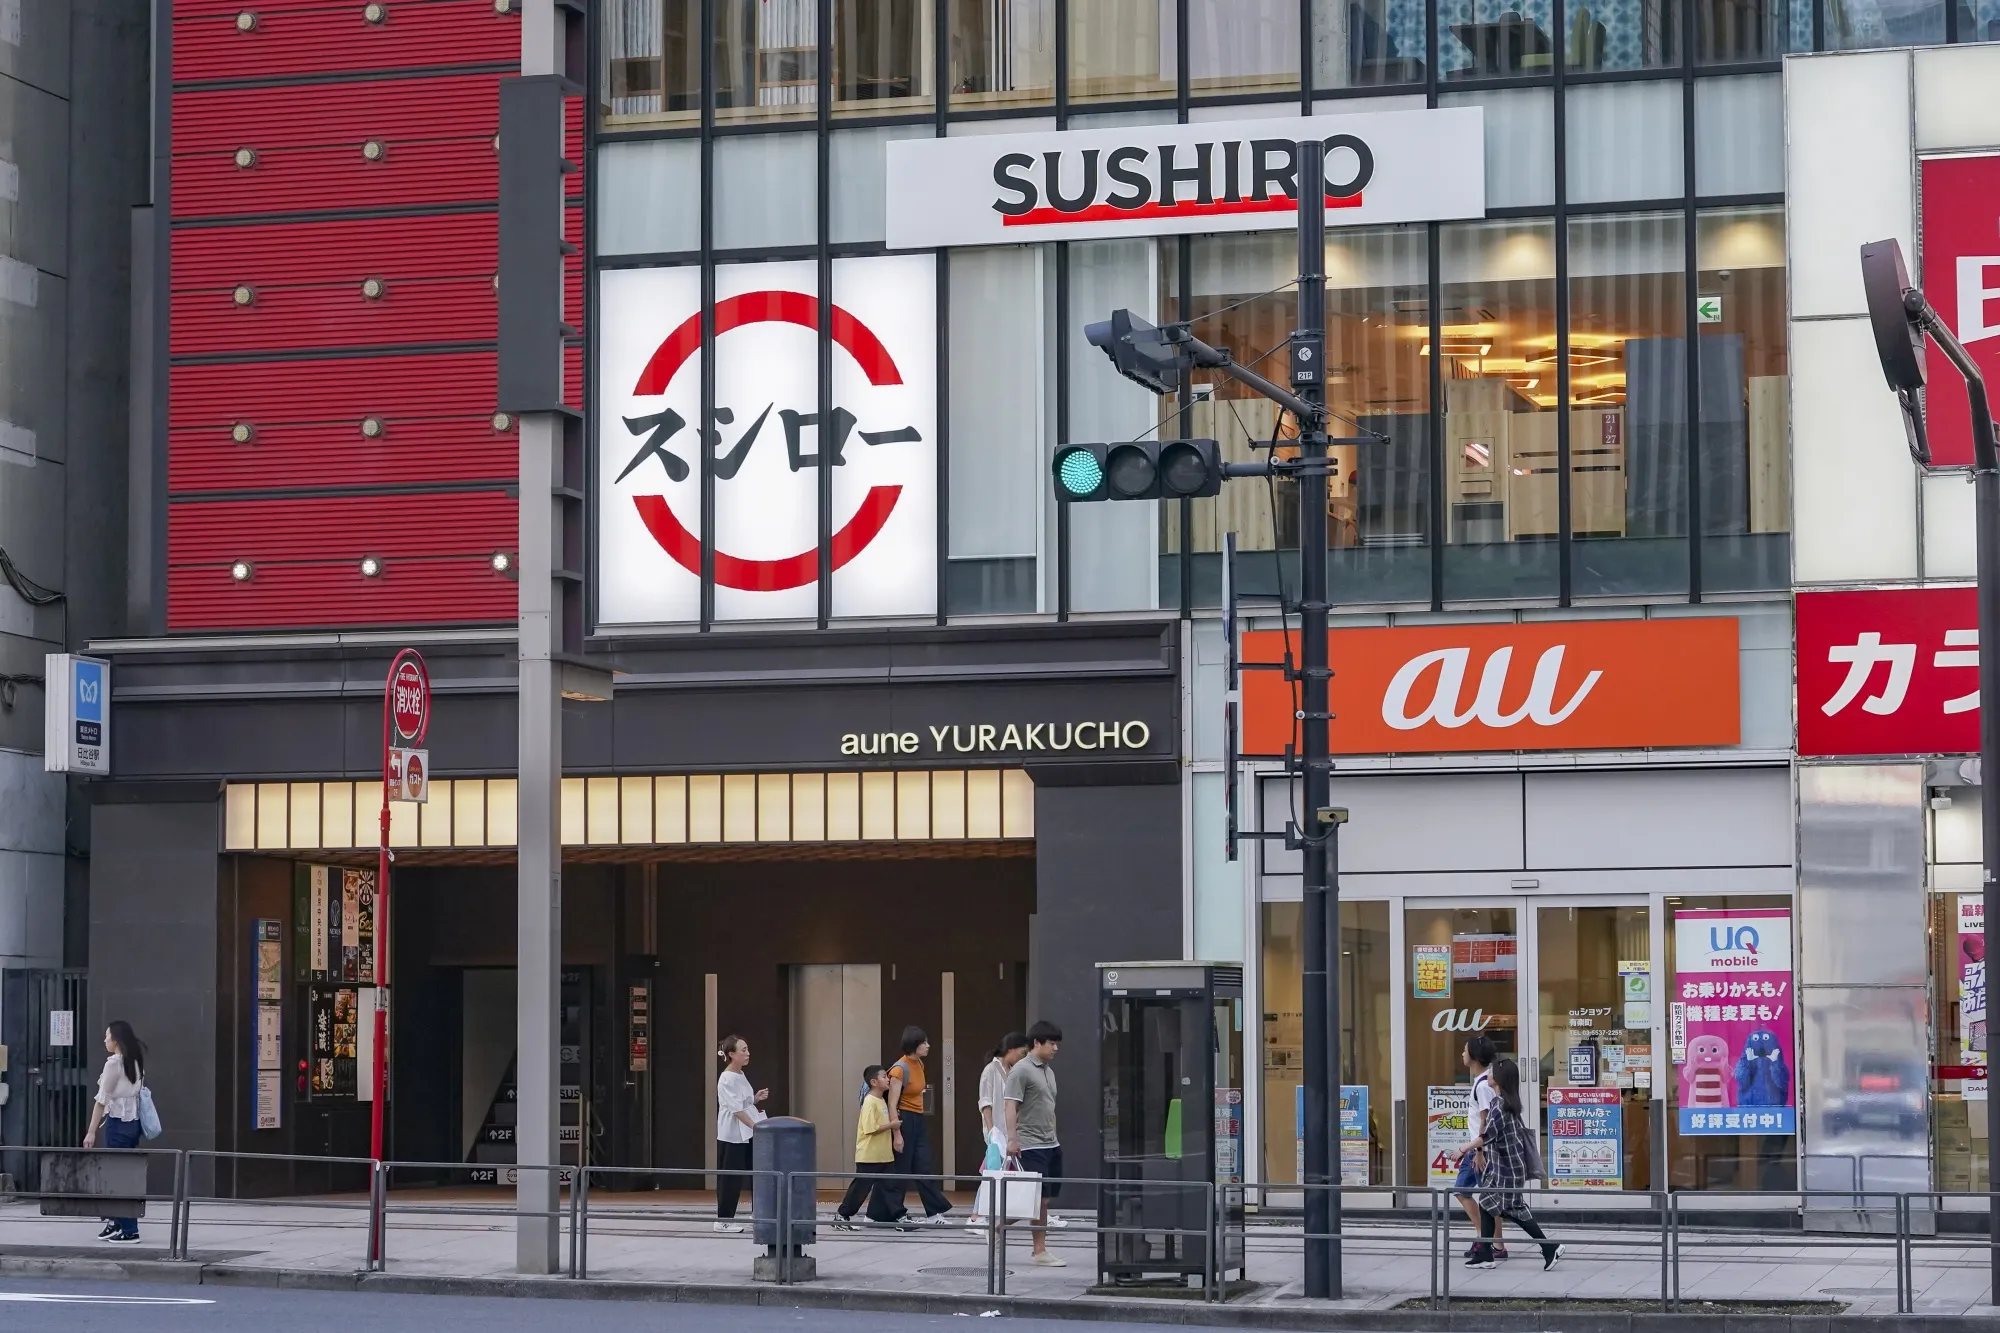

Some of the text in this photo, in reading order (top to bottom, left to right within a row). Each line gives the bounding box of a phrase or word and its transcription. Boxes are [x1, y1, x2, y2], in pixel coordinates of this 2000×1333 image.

[991, 133, 1374, 216] SUSHIRO
[1298, 372, 1312, 380] 21P
[1605, 415, 1616, 424] 21
[614, 400, 922, 485] スシロー
[1605, 435, 1616, 444] 27
[1382, 643, 1603, 730] au
[397, 686, 421, 715] 消火栓
[840, 720, 1150, 755] aune YURAKUCHO
[77, 747, 100, 761] 日比谷駅
[409, 773, 422, 786] ガスト
[1710, 925, 1760, 955] UQ
[1711, 956, 1759, 967] mobile
[1431, 1008, 1493, 1032] au
[1569, 1018, 1593, 1027] 有楽町
[1674, 1004, 1683, 1046] 防犯カメラ作動中
[1433, 1099, 1470, 1109] iPhon
[1557, 1107, 1612, 1118] 家族みんなで
[1552, 1119, 1584, 1136] 割引
[498, 1130, 512, 1140] 2F
[480, 1171, 494, 1181] 2F
